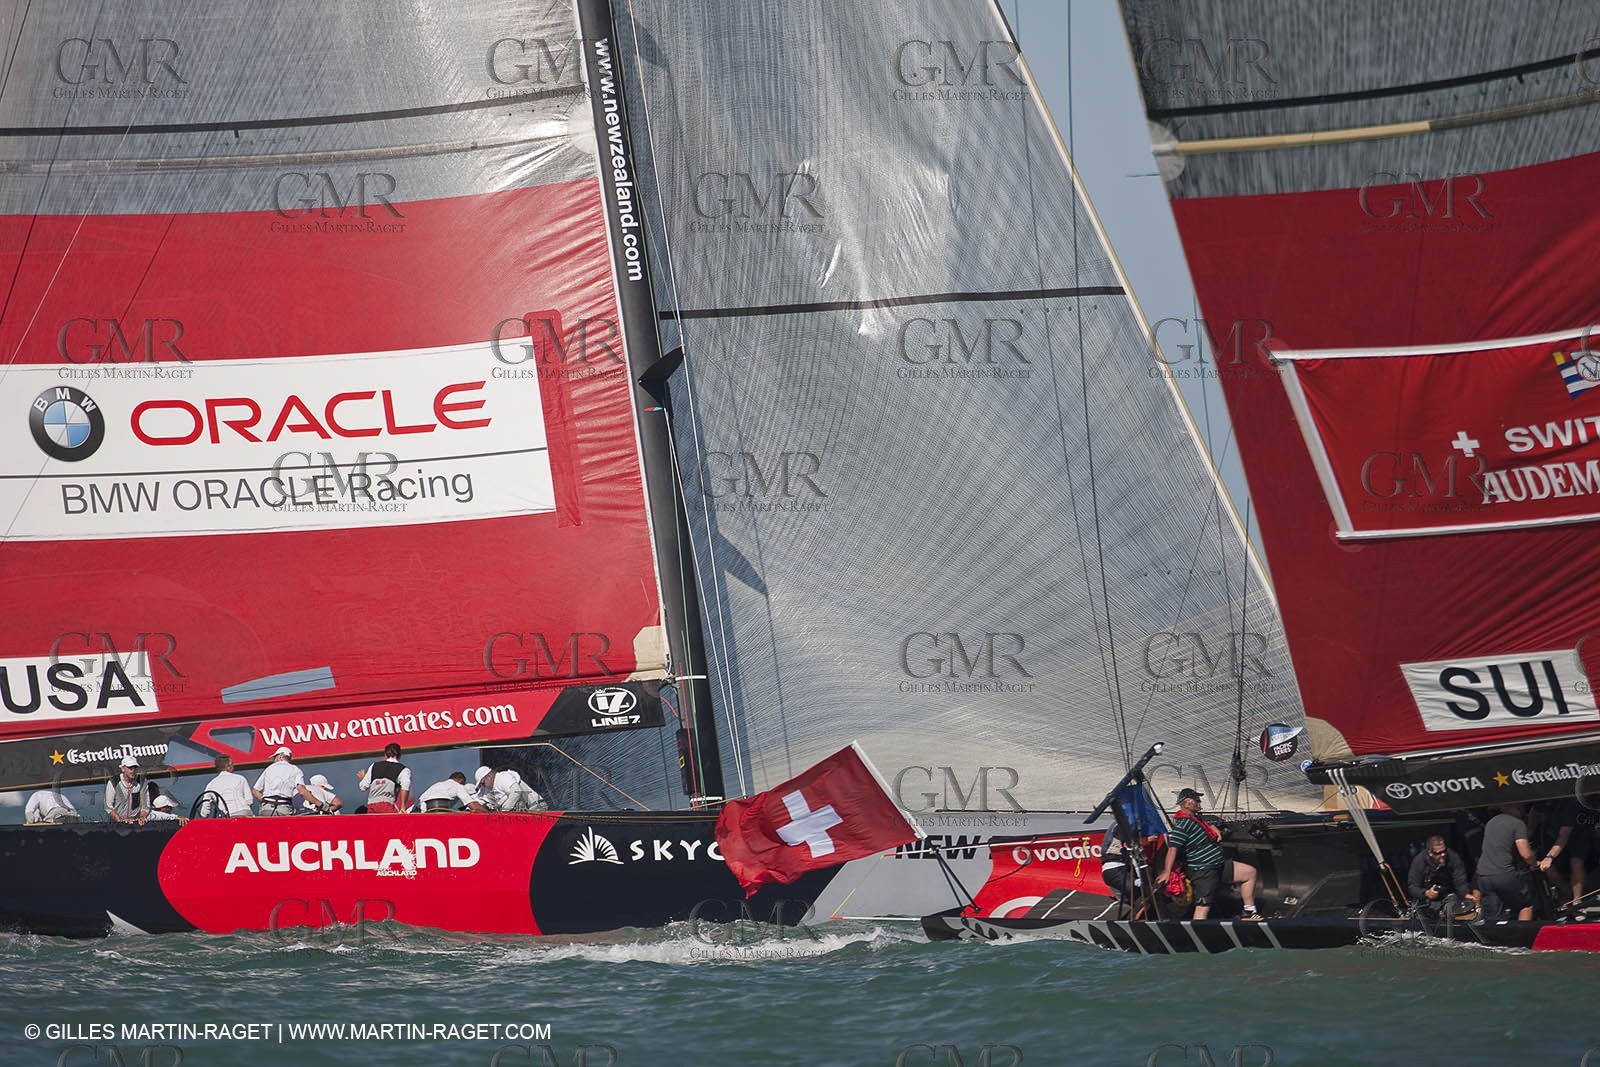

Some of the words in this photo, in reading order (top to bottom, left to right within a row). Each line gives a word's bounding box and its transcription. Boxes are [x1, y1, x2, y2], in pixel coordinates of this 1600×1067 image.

[595, 38, 642, 281] www.newzealand.com
[34, 387, 97, 413] BMW
[130, 380, 492, 446] ORACLE
[61, 481, 161, 514] BMW
[172, 475, 338, 511] ORACLE
[348, 469, 474, 503] Racing
[0, 660, 145, 714] USA
[1438, 660, 1570, 720] SUI
[259, 702, 518, 746] www.emirates.com
[1411, 776, 1485, 796] TOYOTA
[224, 837, 480, 873] AUCKLAND
[895, 835, 981, 859] NEW
